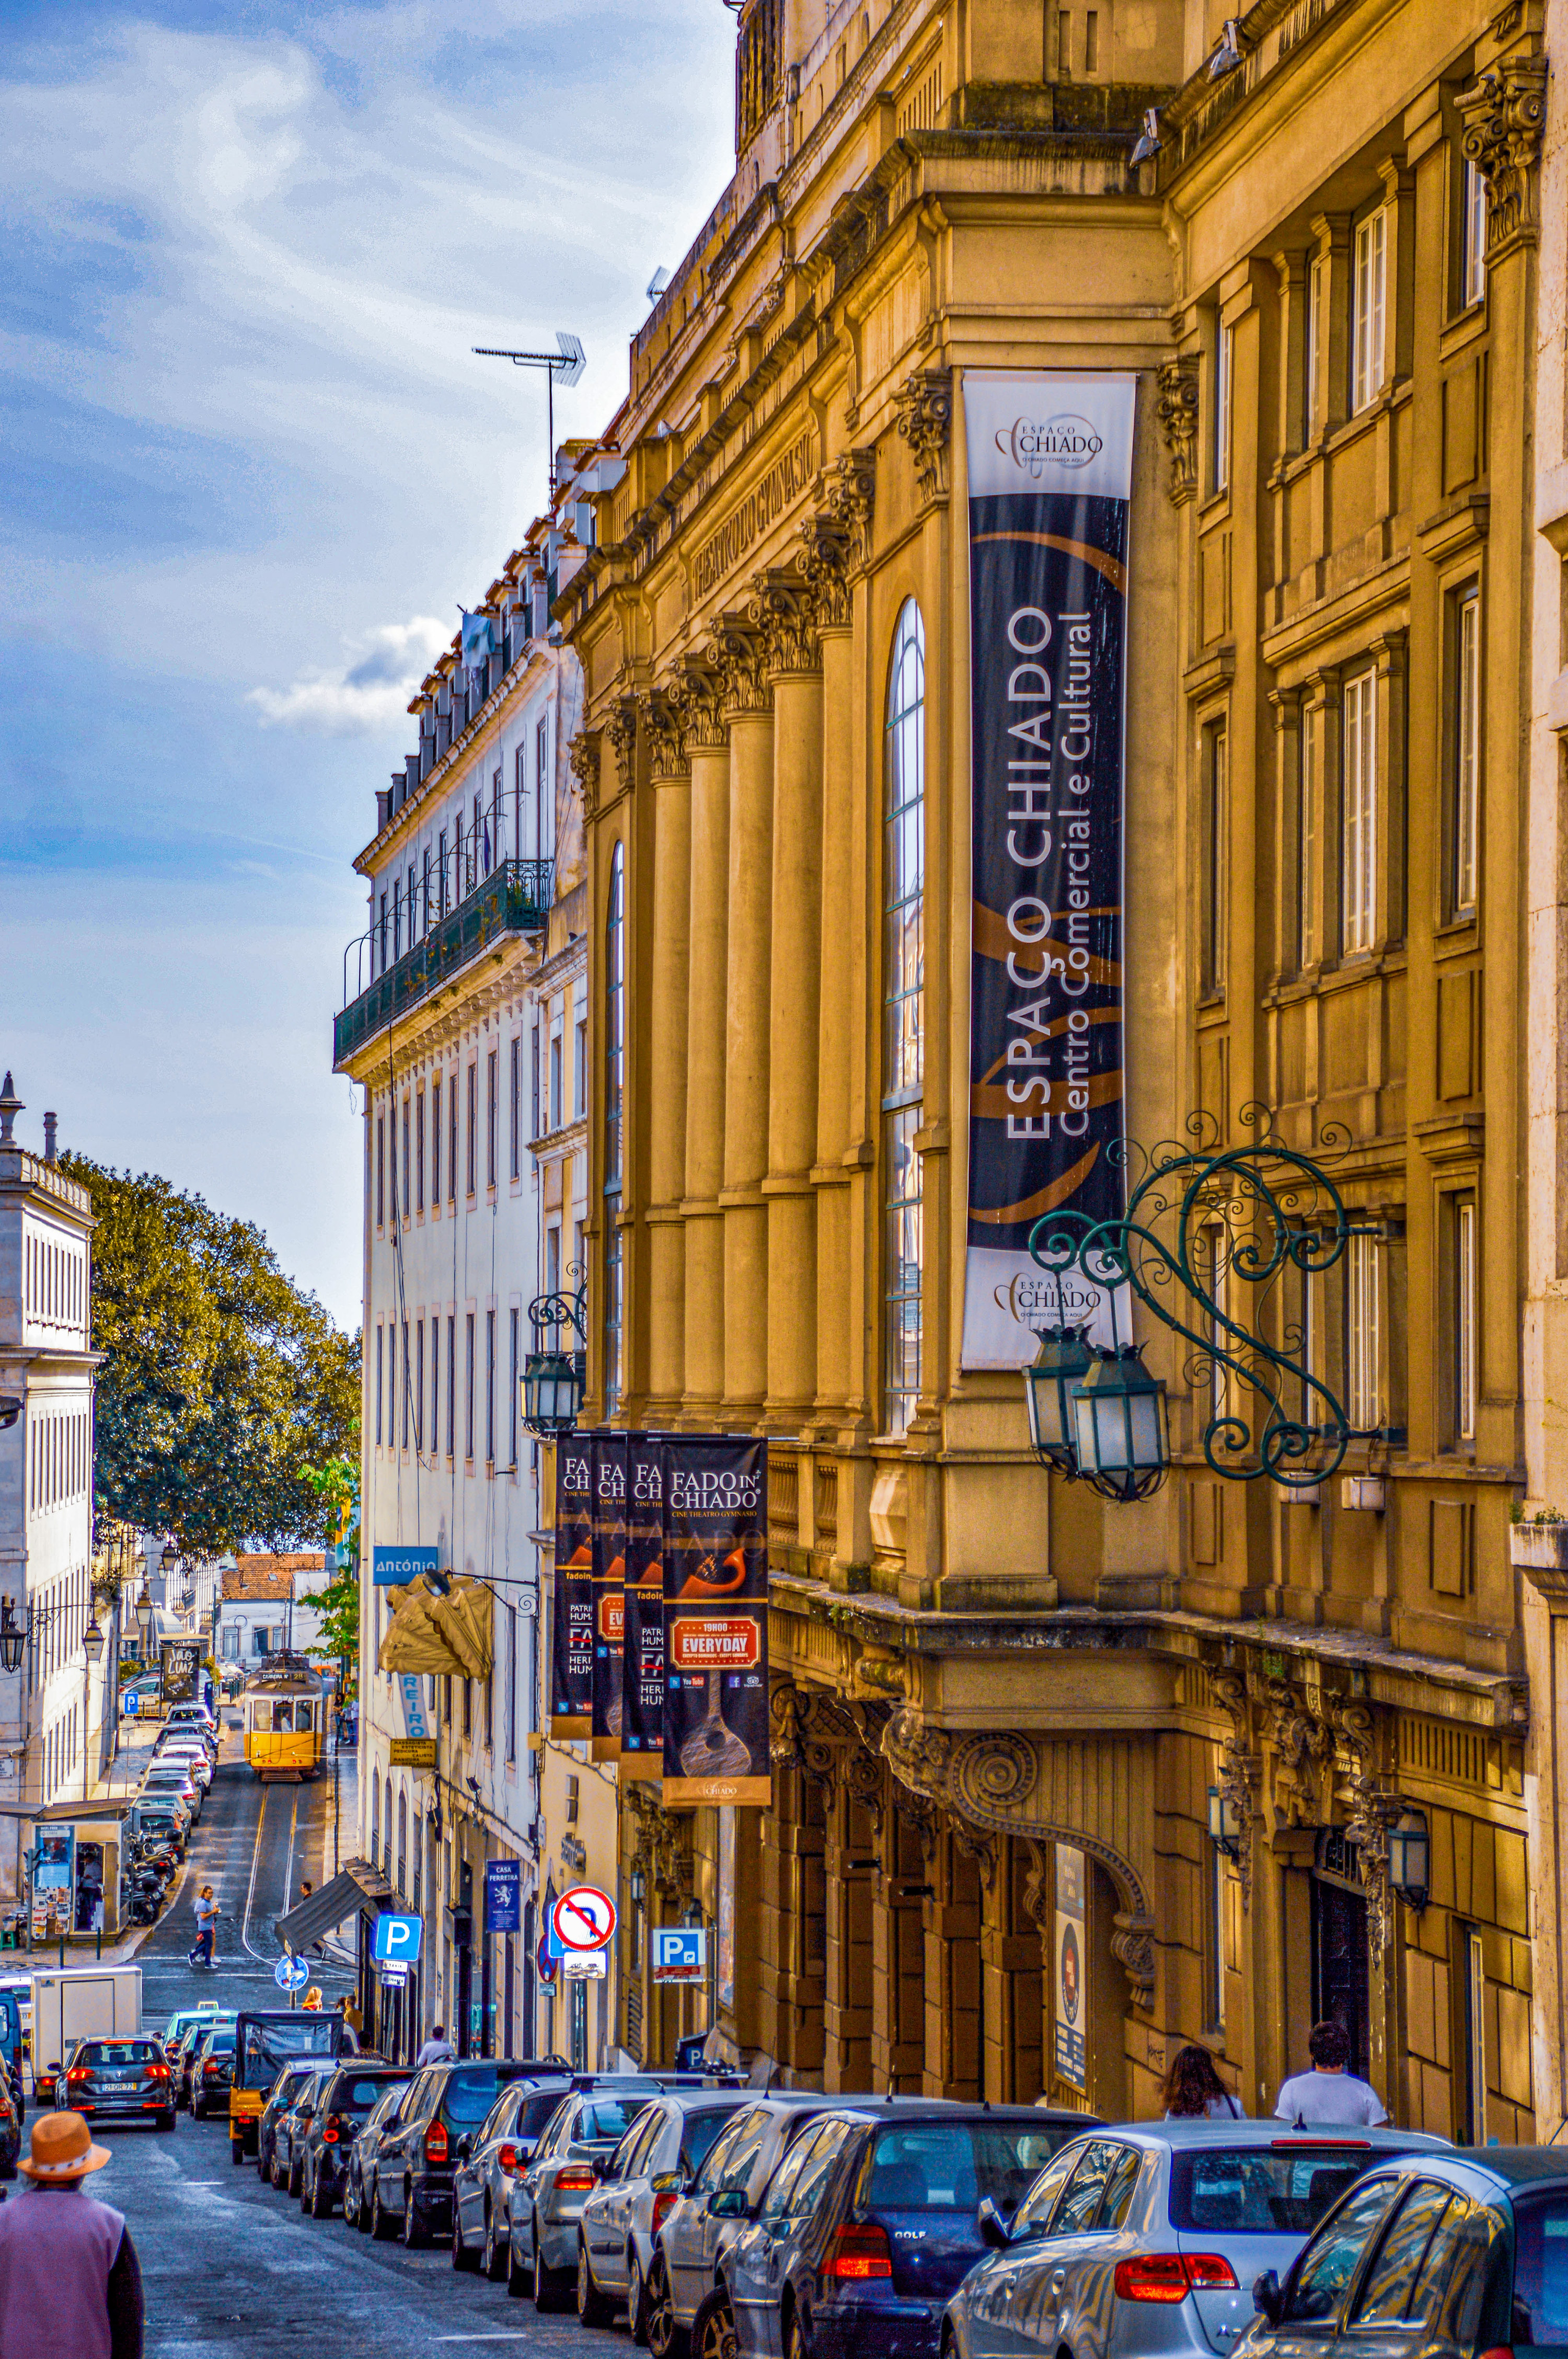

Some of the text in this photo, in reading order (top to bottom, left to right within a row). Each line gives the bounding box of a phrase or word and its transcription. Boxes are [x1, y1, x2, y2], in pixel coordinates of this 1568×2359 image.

[1023, 427, 1075, 436] ESPAÇO
[1020, 436, 1103, 453] CHIADO
[1007, 607, 1065, 1139] ESPAÇO CHIADO
[1058, 612, 1091, 1136] Centro Comercial e Cultural
[1019, 1291, 1101, 1308] CHIADO
[672, 1472, 757, 1491] FADO IN
[671, 1492, 757, 1509] CHIADO
[704, 1623, 728, 1632] 19H00
[683, 1638, 747, 1652] EVERYDAY
[128, 1696, 135, 1711] P
[386, 1921, 410, 1954] P
[664, 1937, 684, 1964] P
[691, 2050, 701, 2066] P
[895, 2231, 926, 2239] GOLF
